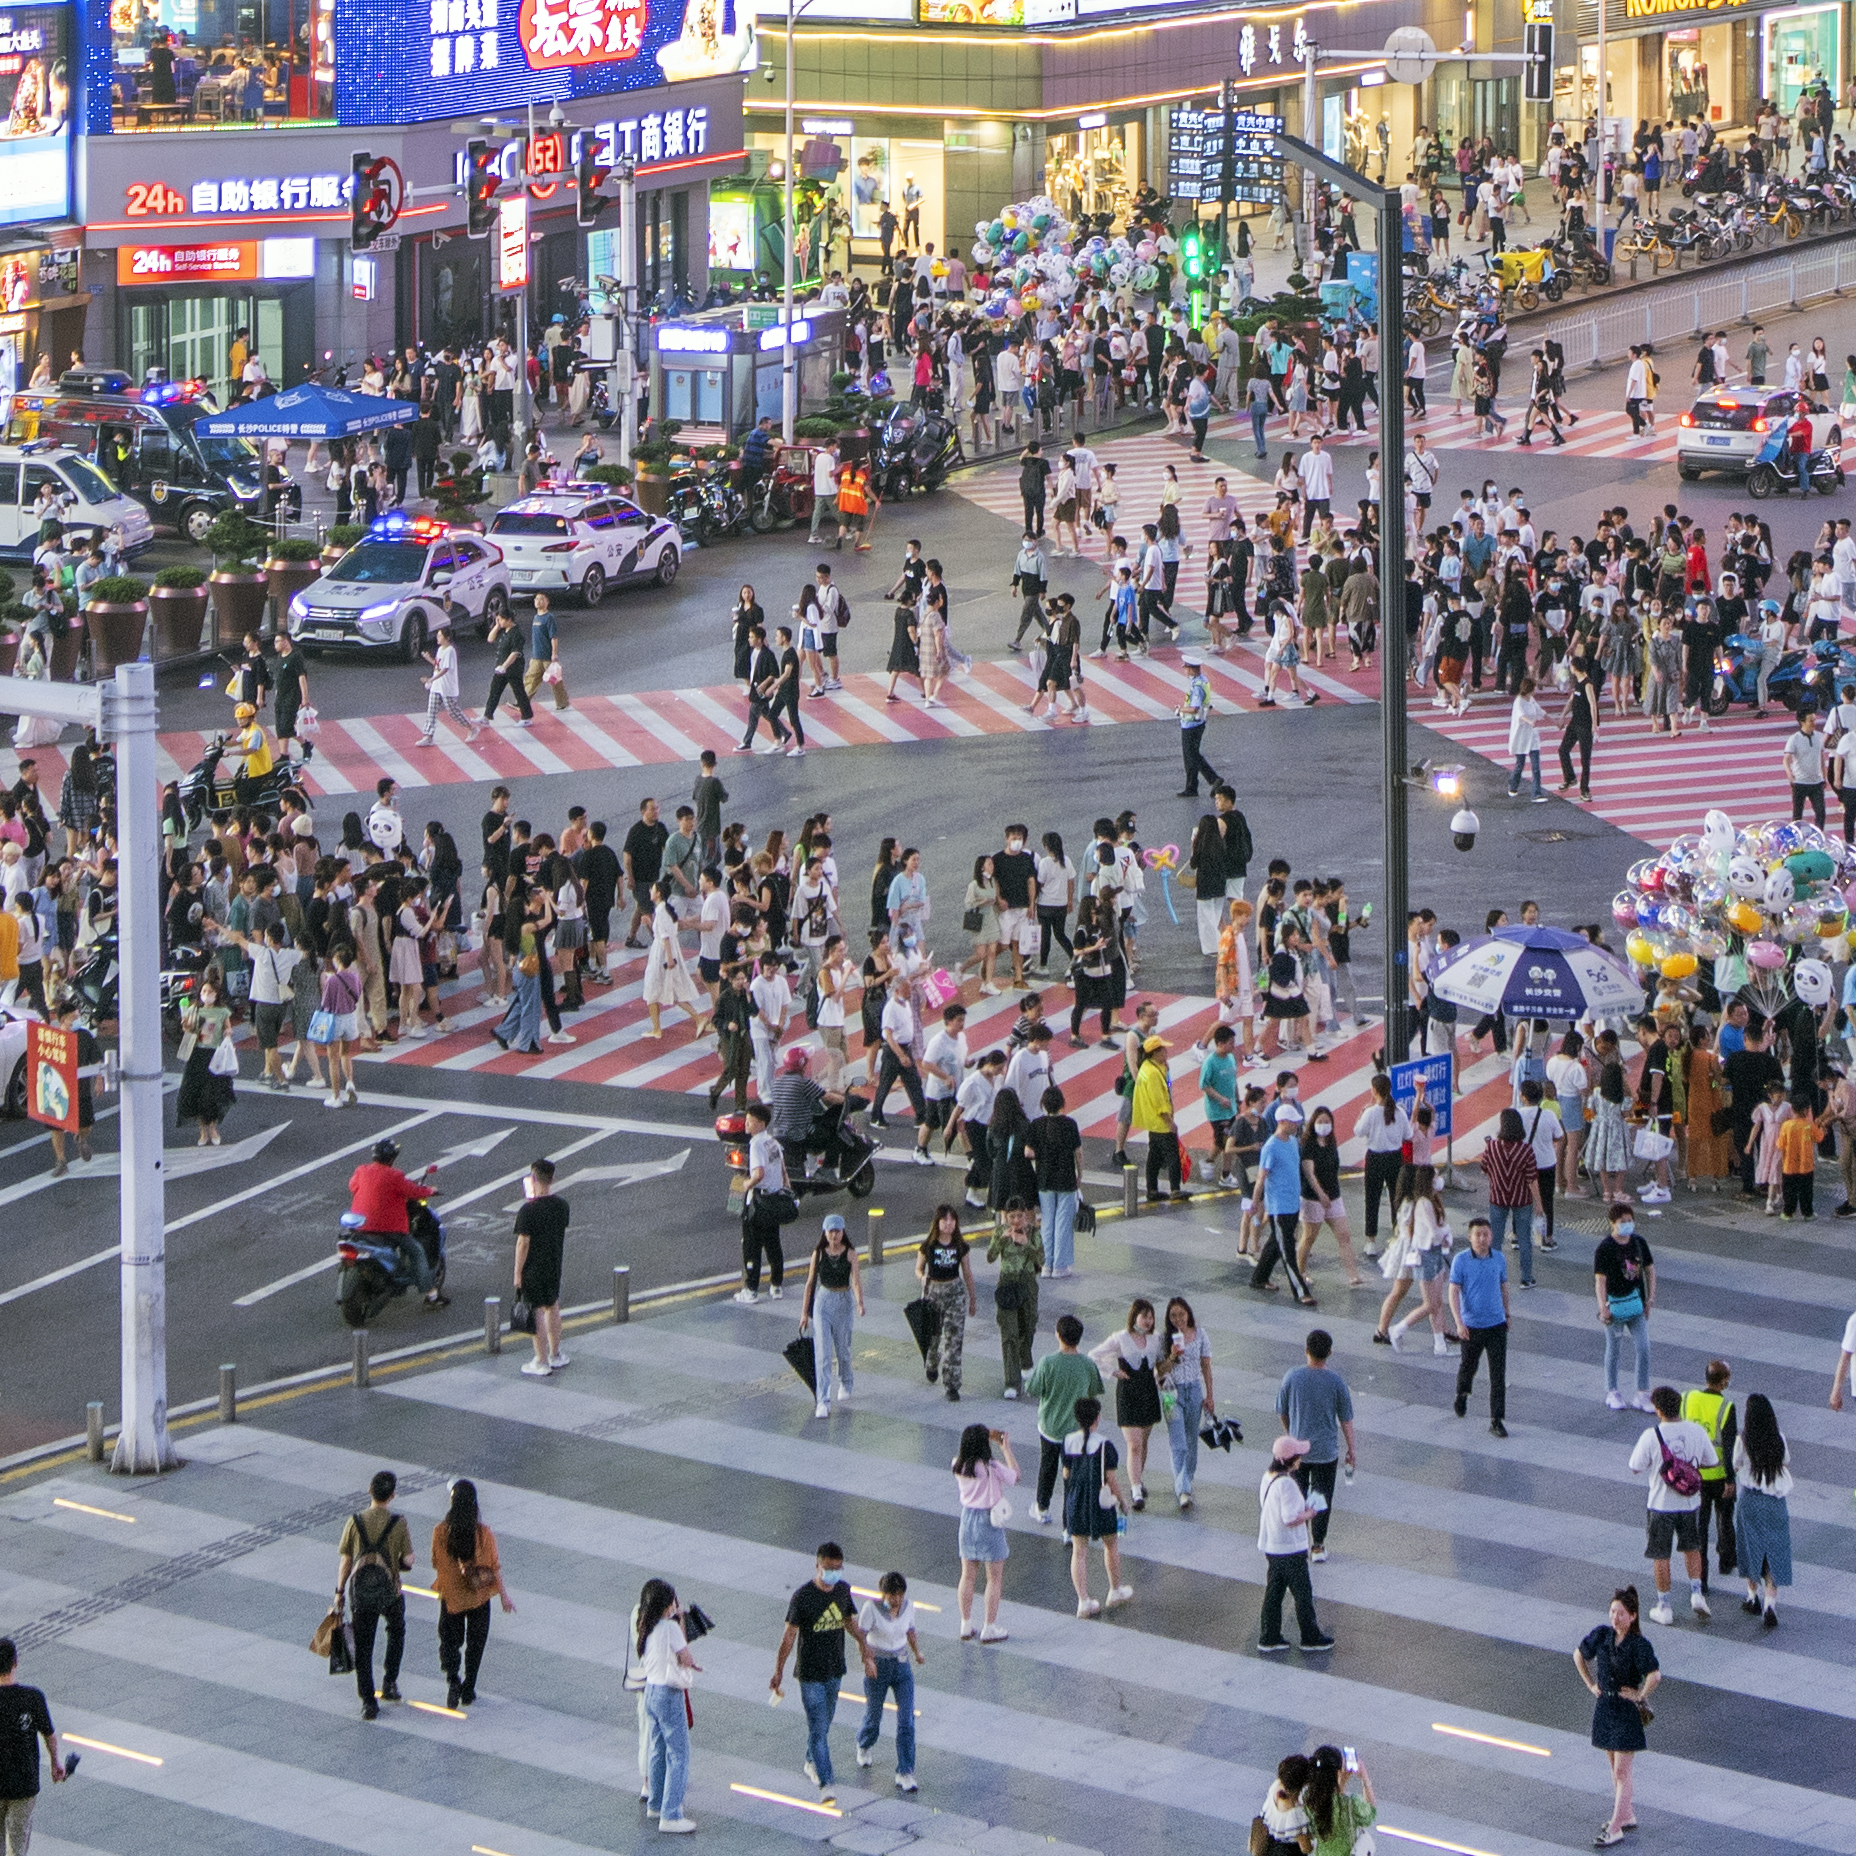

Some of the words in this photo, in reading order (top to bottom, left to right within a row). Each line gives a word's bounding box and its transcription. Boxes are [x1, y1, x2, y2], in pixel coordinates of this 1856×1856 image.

[126, 183, 185, 216] 24h
[132, 250, 171, 273] 24h
[174, 247, 240, 262] 自助银行服务
[238, 423, 299, 436] 长沙POLICE特警
